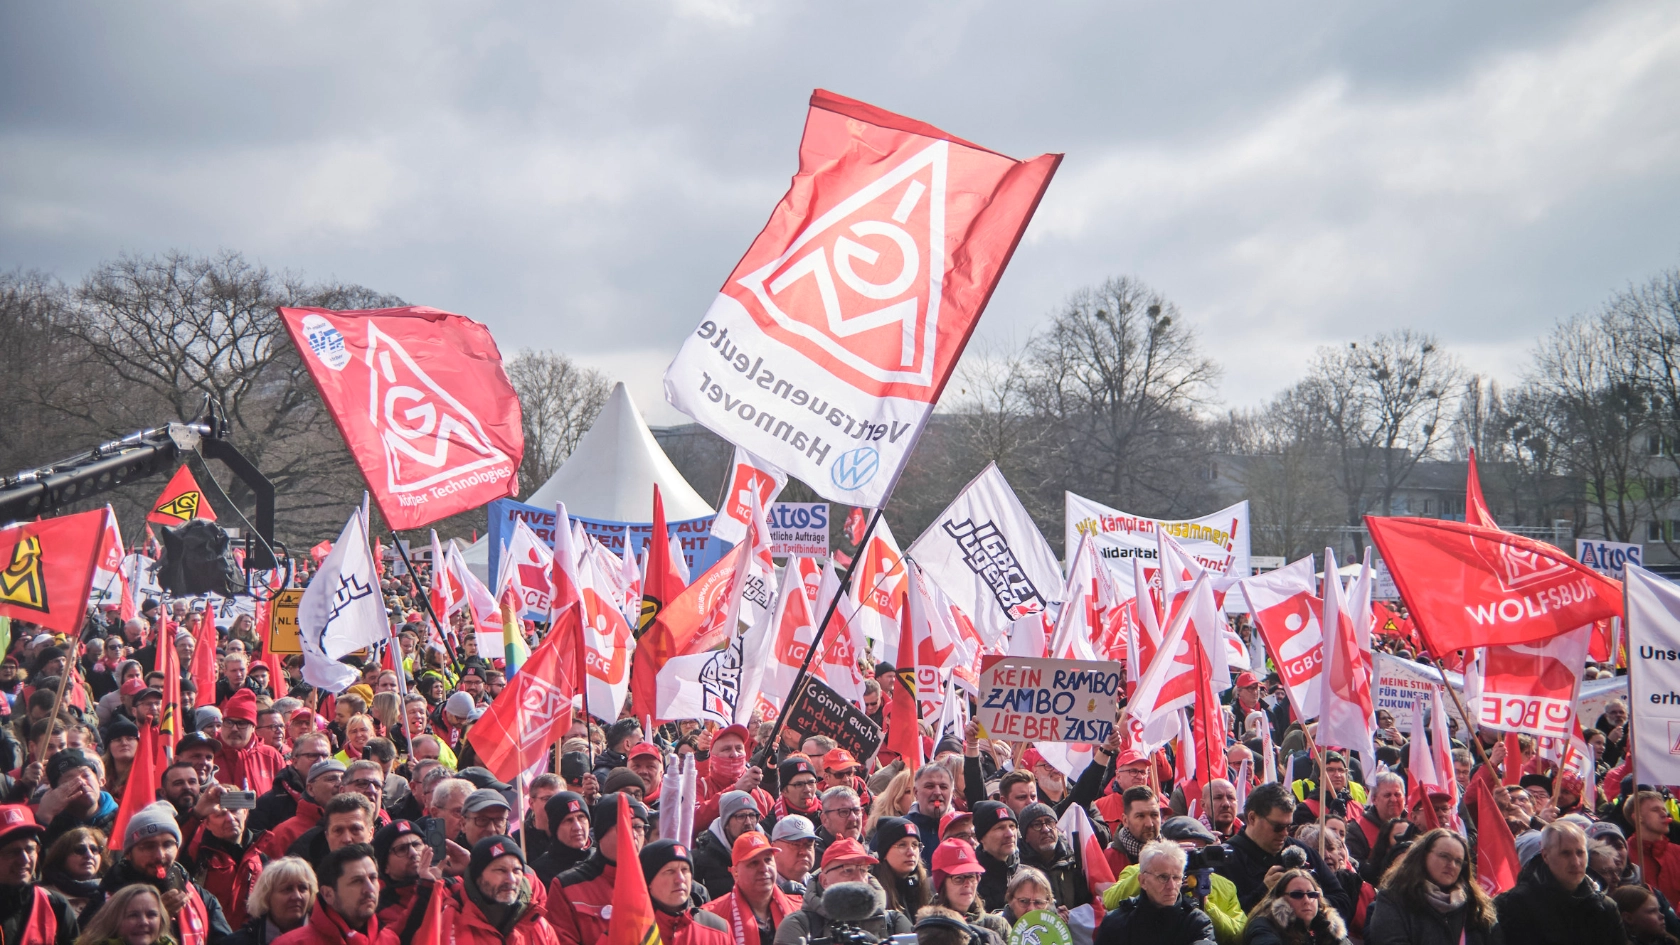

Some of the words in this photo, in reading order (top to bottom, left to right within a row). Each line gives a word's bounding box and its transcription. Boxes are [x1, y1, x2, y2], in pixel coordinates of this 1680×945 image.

[429, 465, 512, 499] Technologies
[1099, 514, 1155, 535] kämpfen
[769, 531, 793, 542] atliche
[795, 532, 825, 544] Aufträge
[783, 544, 827, 556] Tarifbindung
[942, 517, 1022, 608] Jugend
[1193, 554, 1231, 573] innt!
[1640, 645, 1680, 661] Uns
[992, 669, 1042, 688] KEIN
[1053, 669, 1120, 697] RAMBO
[1378, 686, 1398, 697] FÜR
[1379, 677, 1408, 688] MEINE
[982, 688, 1076, 716] ZAMBO
[806, 683, 848, 718] Gönnt
[849, 716, 877, 743] euch:
[1014, 918, 1029, 935] FÜR
[1040, 912, 1056, 925] WIR
[1054, 920, 1069, 941] SIND
